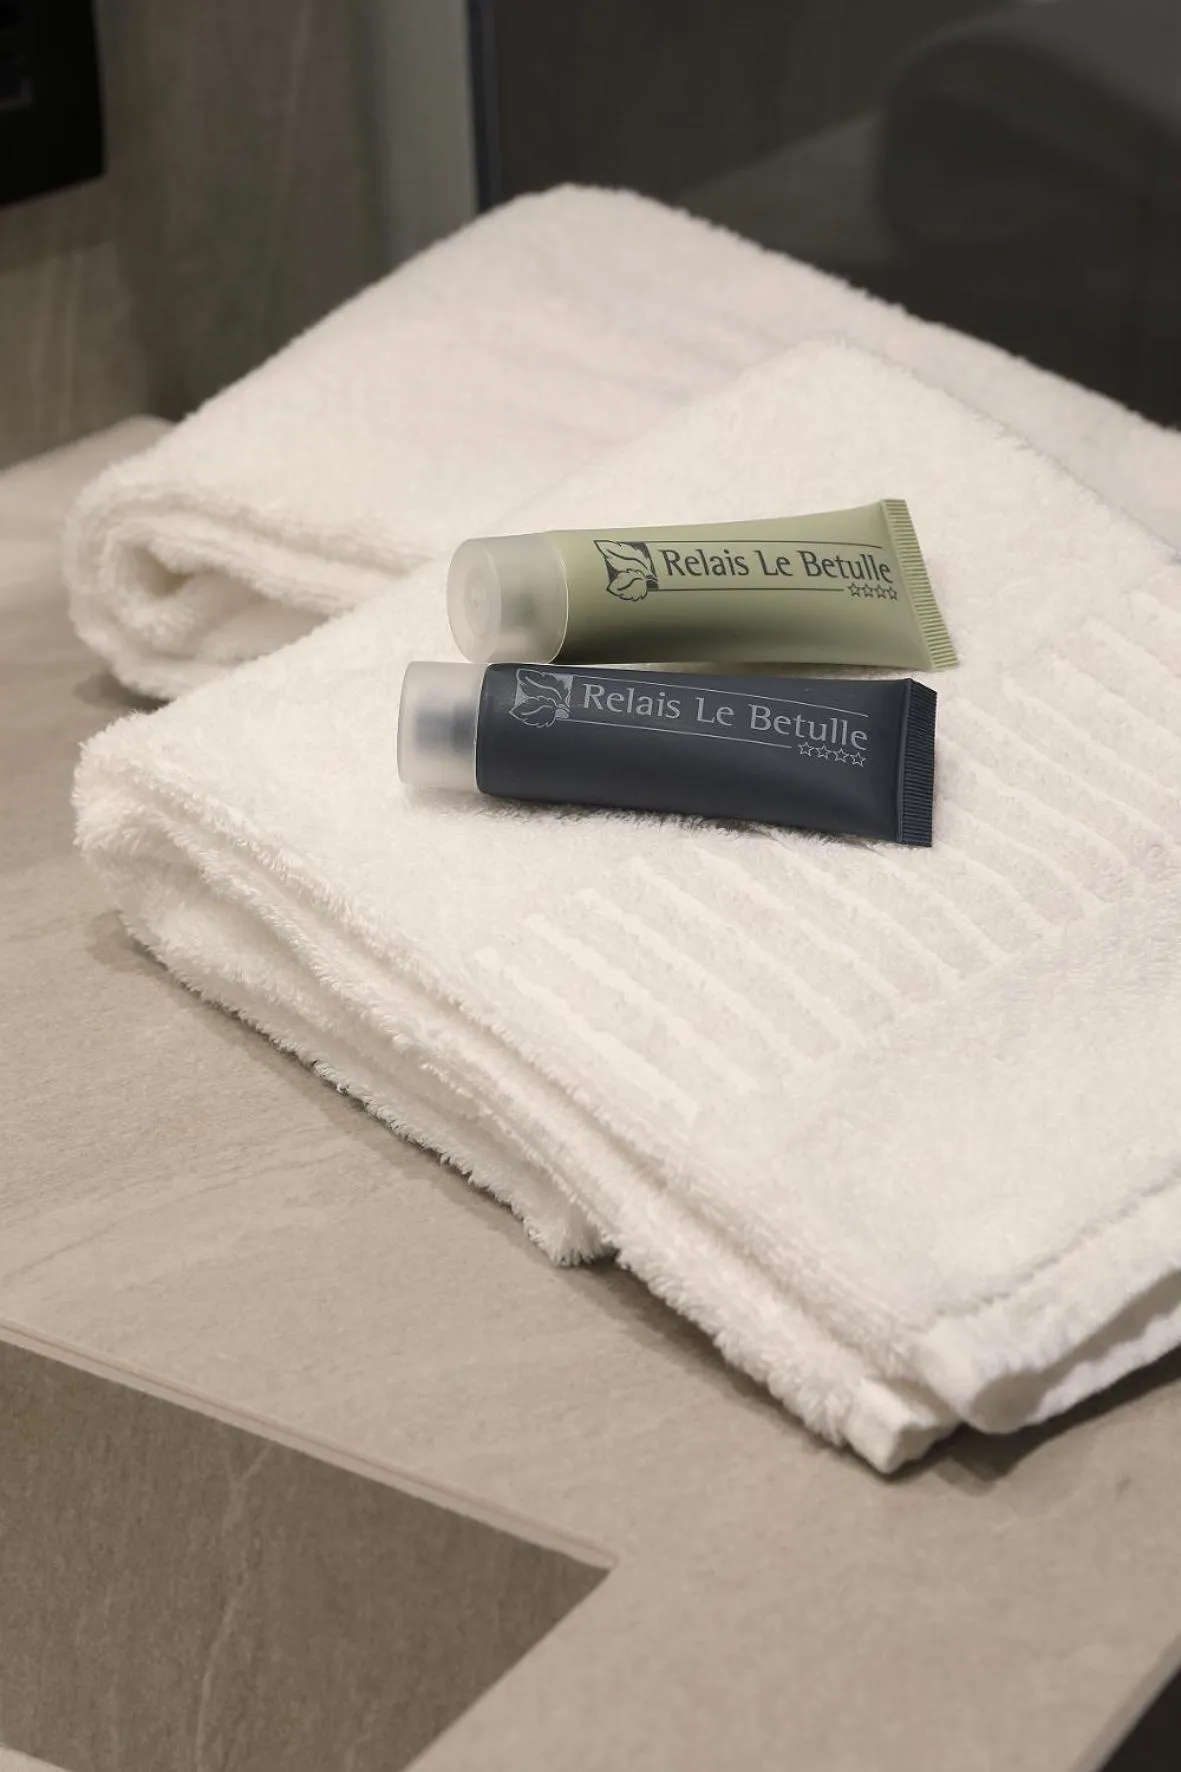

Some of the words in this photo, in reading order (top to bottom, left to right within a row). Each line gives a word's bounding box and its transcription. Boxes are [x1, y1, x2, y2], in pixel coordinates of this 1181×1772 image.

[662, 549, 749, 576] Relais
[754, 550, 793, 576] Le
[797, 550, 894, 583] Betulle
[582, 683, 681, 719] Relais
[695, 697, 734, 726] Le
[749, 704, 867, 750] Betulle
